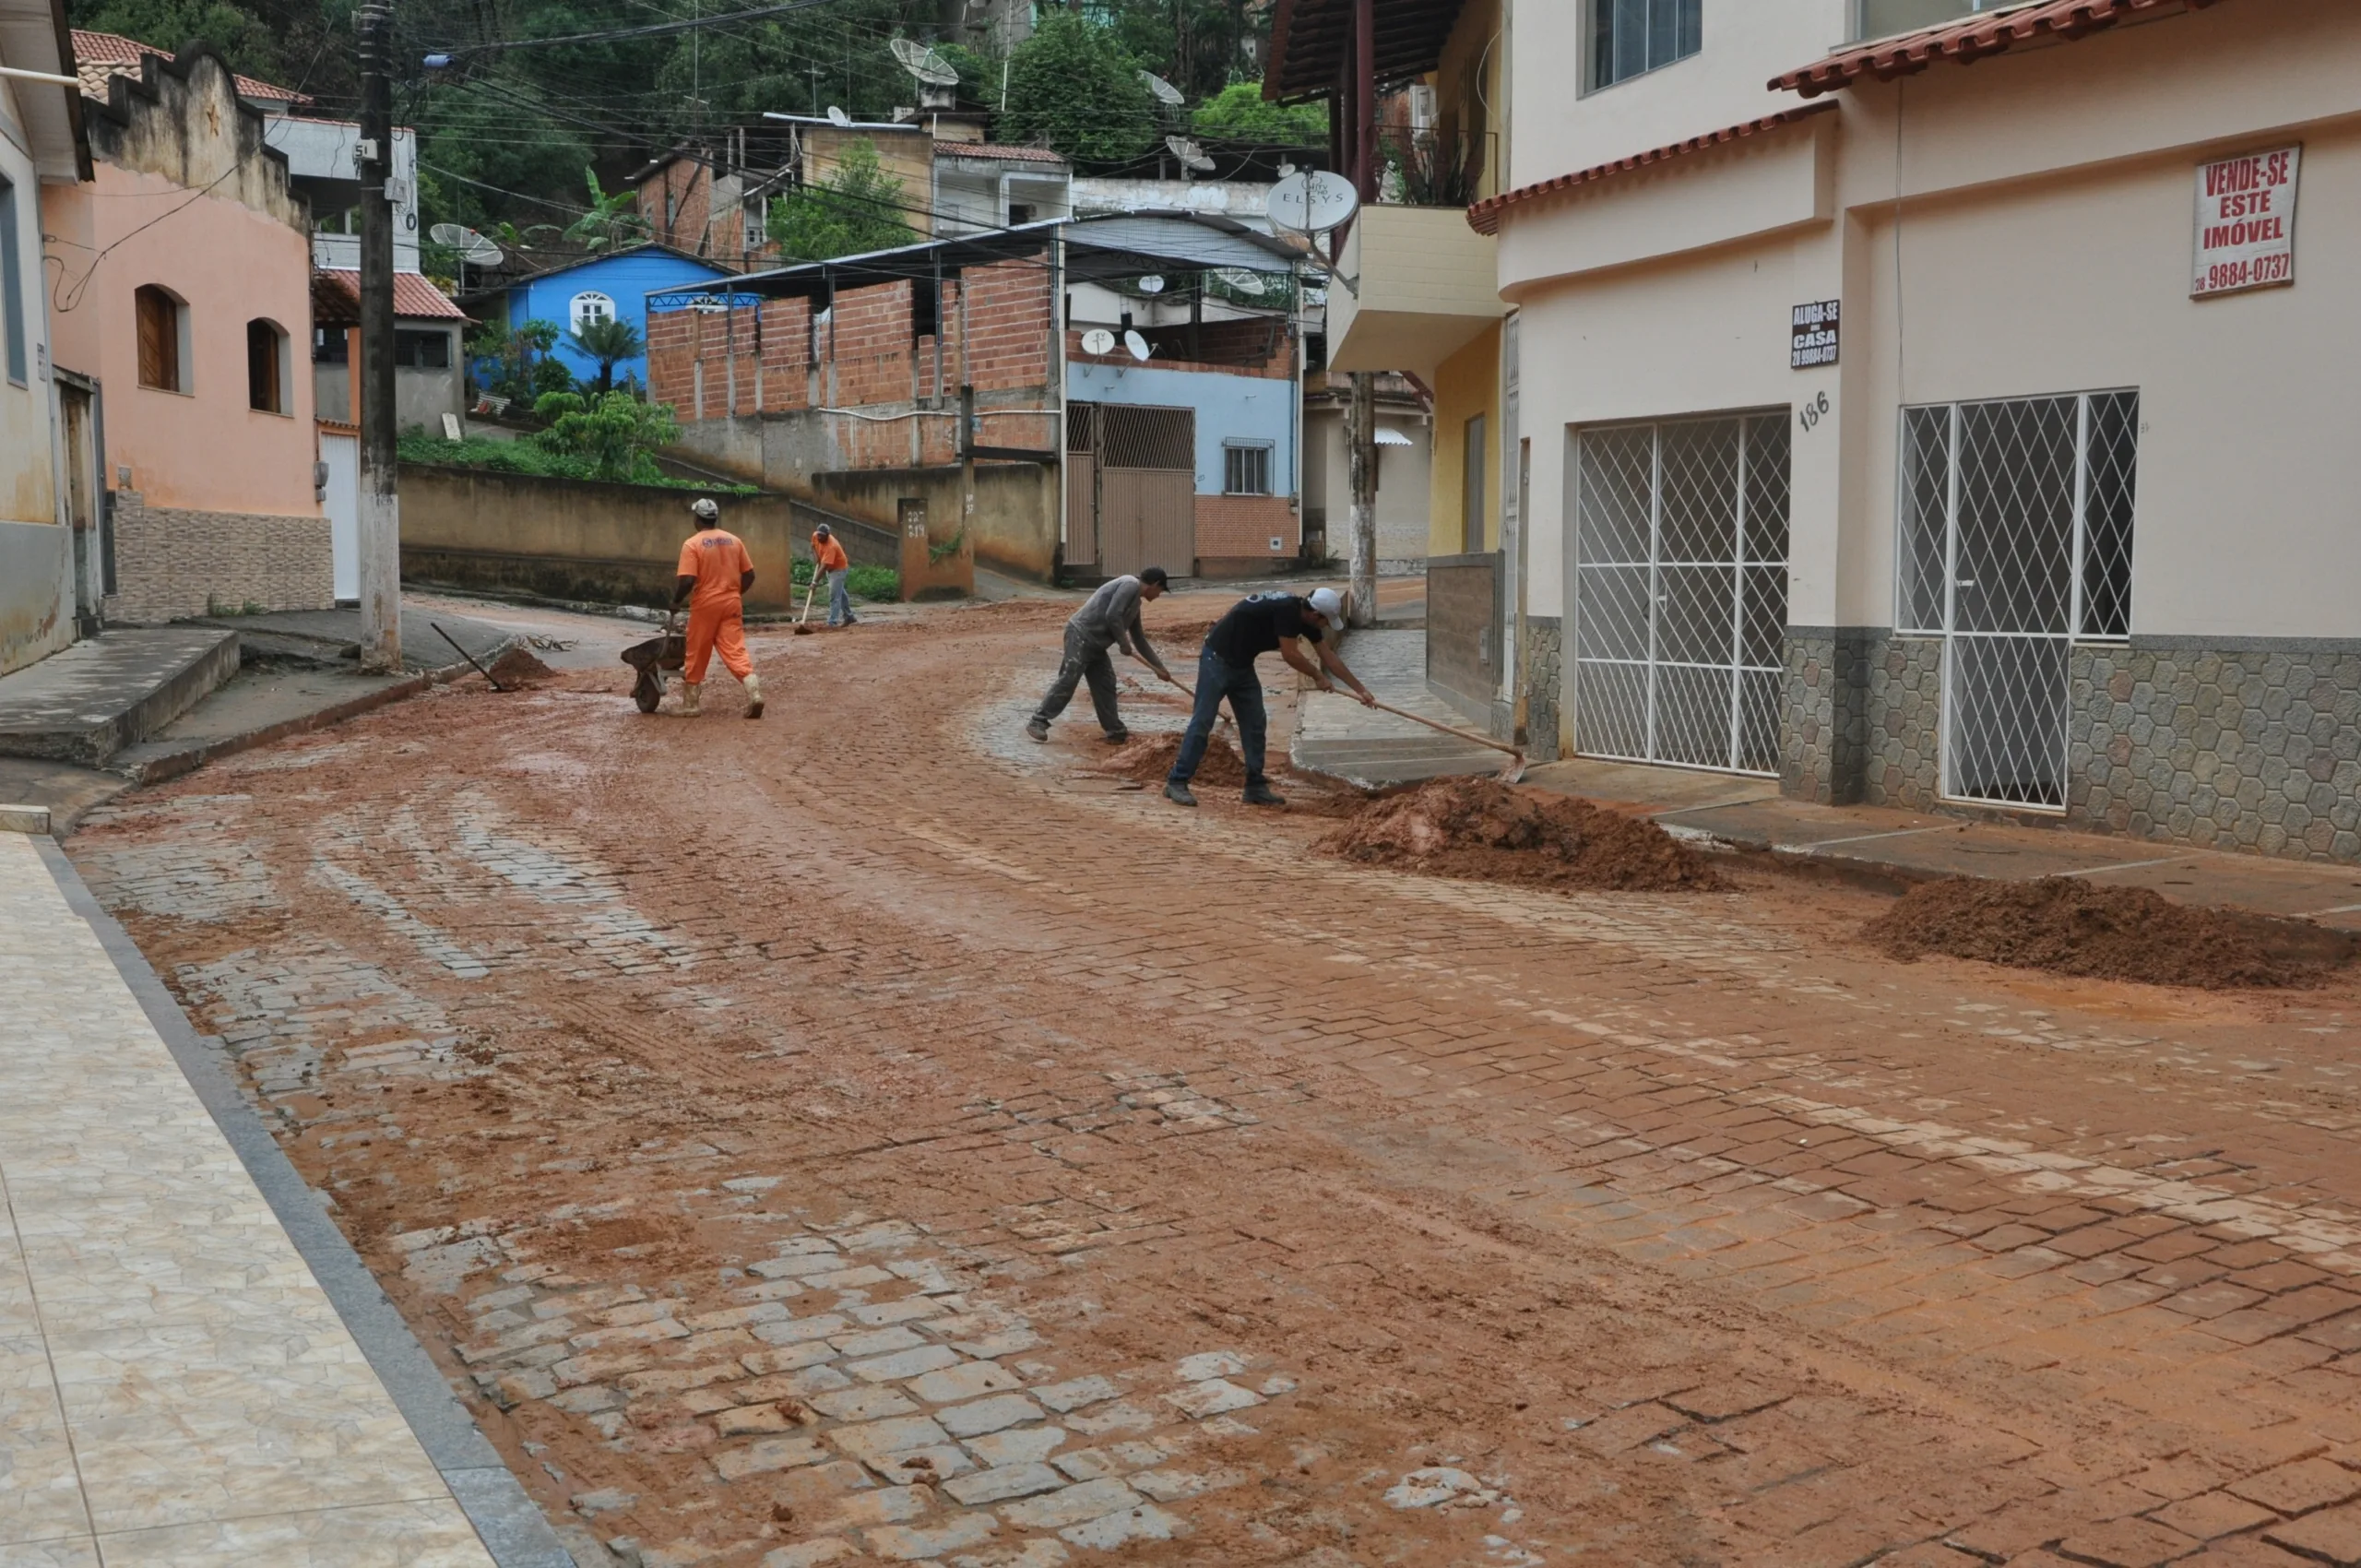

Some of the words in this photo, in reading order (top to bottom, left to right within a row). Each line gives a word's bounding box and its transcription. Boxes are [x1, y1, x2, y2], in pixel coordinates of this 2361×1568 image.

[2206, 151, 2289, 196] VENDE-SE
[1283, 193, 1343, 205] ELSYS
[2220, 189, 2272, 219] ESTE
[2203, 217, 2284, 250] IMÓVEL
[2195, 278, 2205, 291] 28
[2209, 253, 2289, 289] 9884-0737
[1793, 302, 1838, 326] ALUGA-SE
[1794, 329, 1836, 349] CASA
[1792, 350, 1801, 366] 28
[1799, 390, 1829, 433] 186
